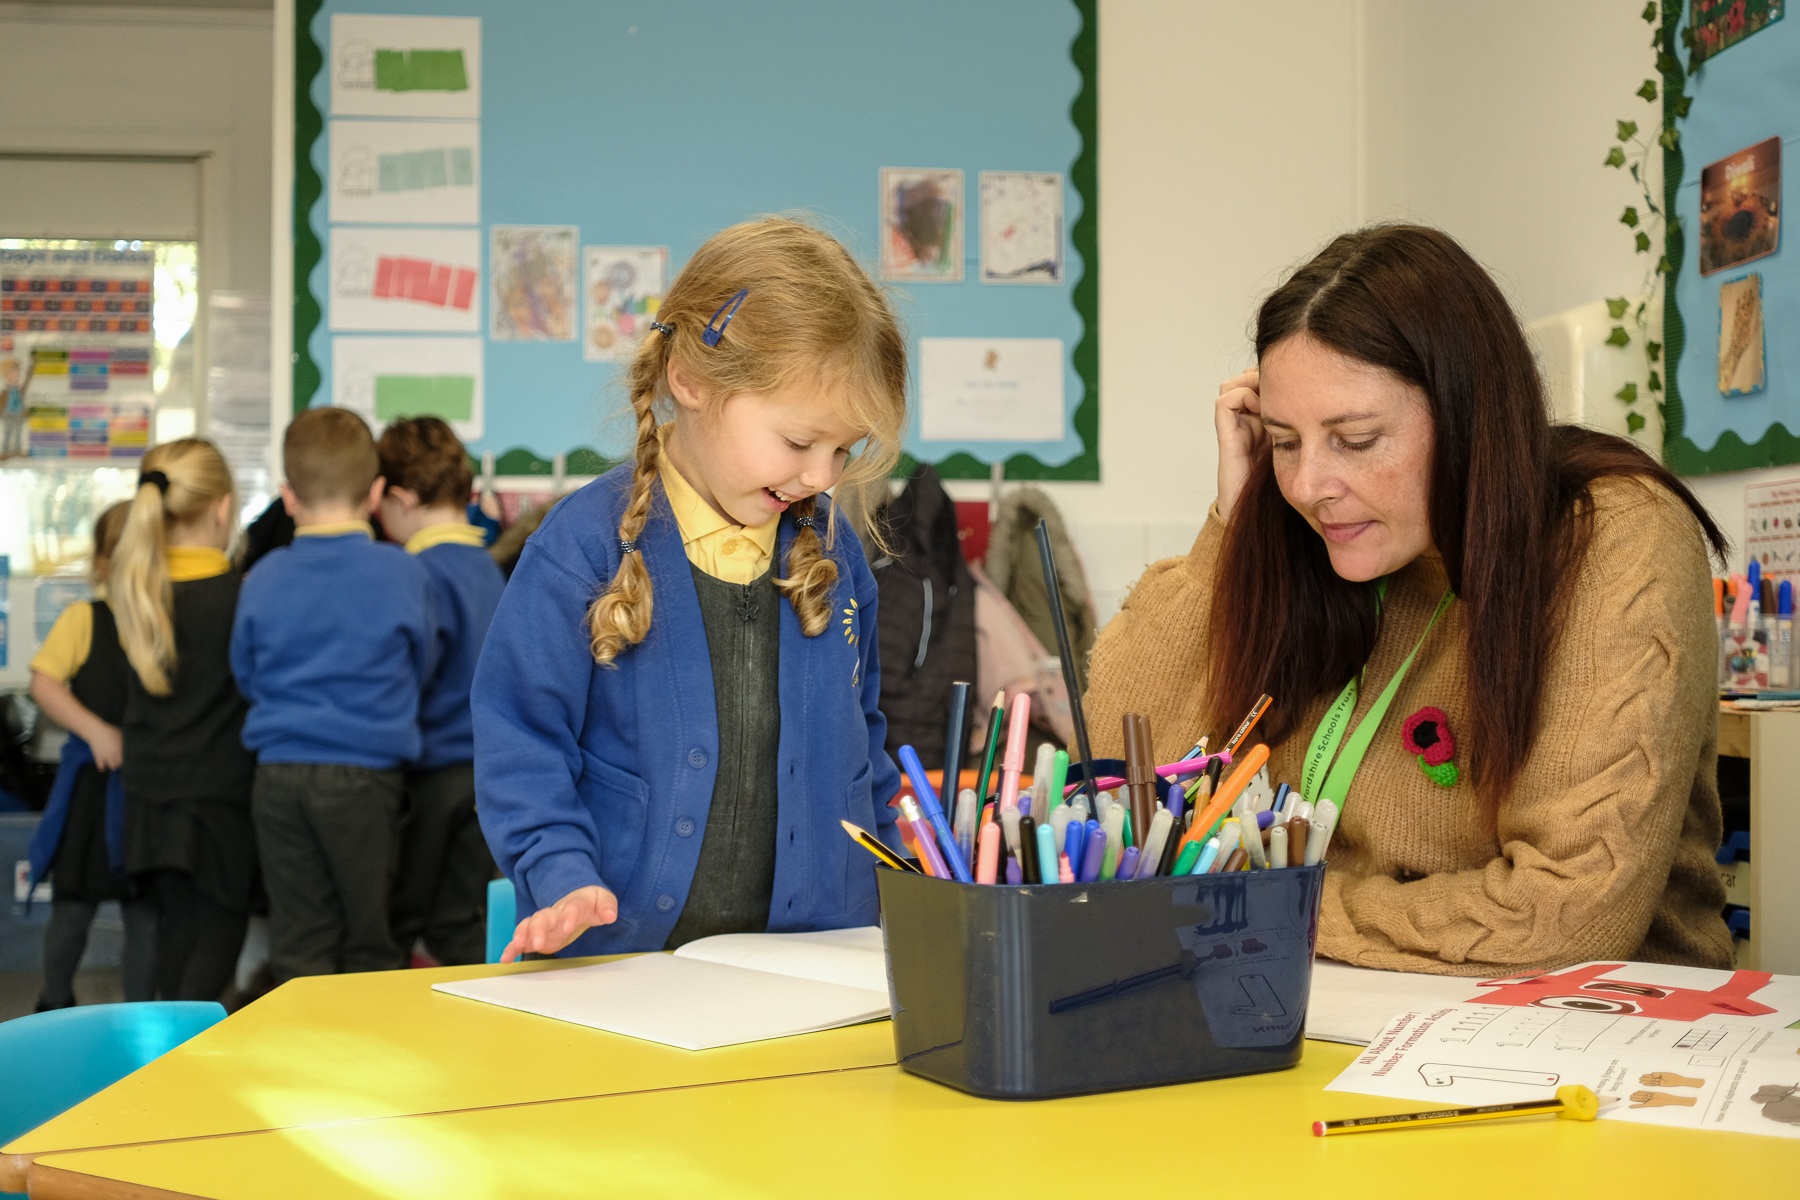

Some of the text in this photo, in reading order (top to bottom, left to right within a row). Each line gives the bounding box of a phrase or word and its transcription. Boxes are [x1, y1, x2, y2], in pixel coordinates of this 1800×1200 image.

[1240, 720, 1250, 734] colour
[1318, 713, 1341, 752] Schools
[1337, 688, 1355, 712] Trust
[1386, 1013, 1417, 1035] Number
[1368, 1036, 1396, 1055] About
[1371, 1052, 1404, 1077] Number
[1395, 1022, 1434, 1051] Formation
[1359, 1055, 1378, 1065] All
[1417, 1110, 1454, 1120] STAEDTLER
